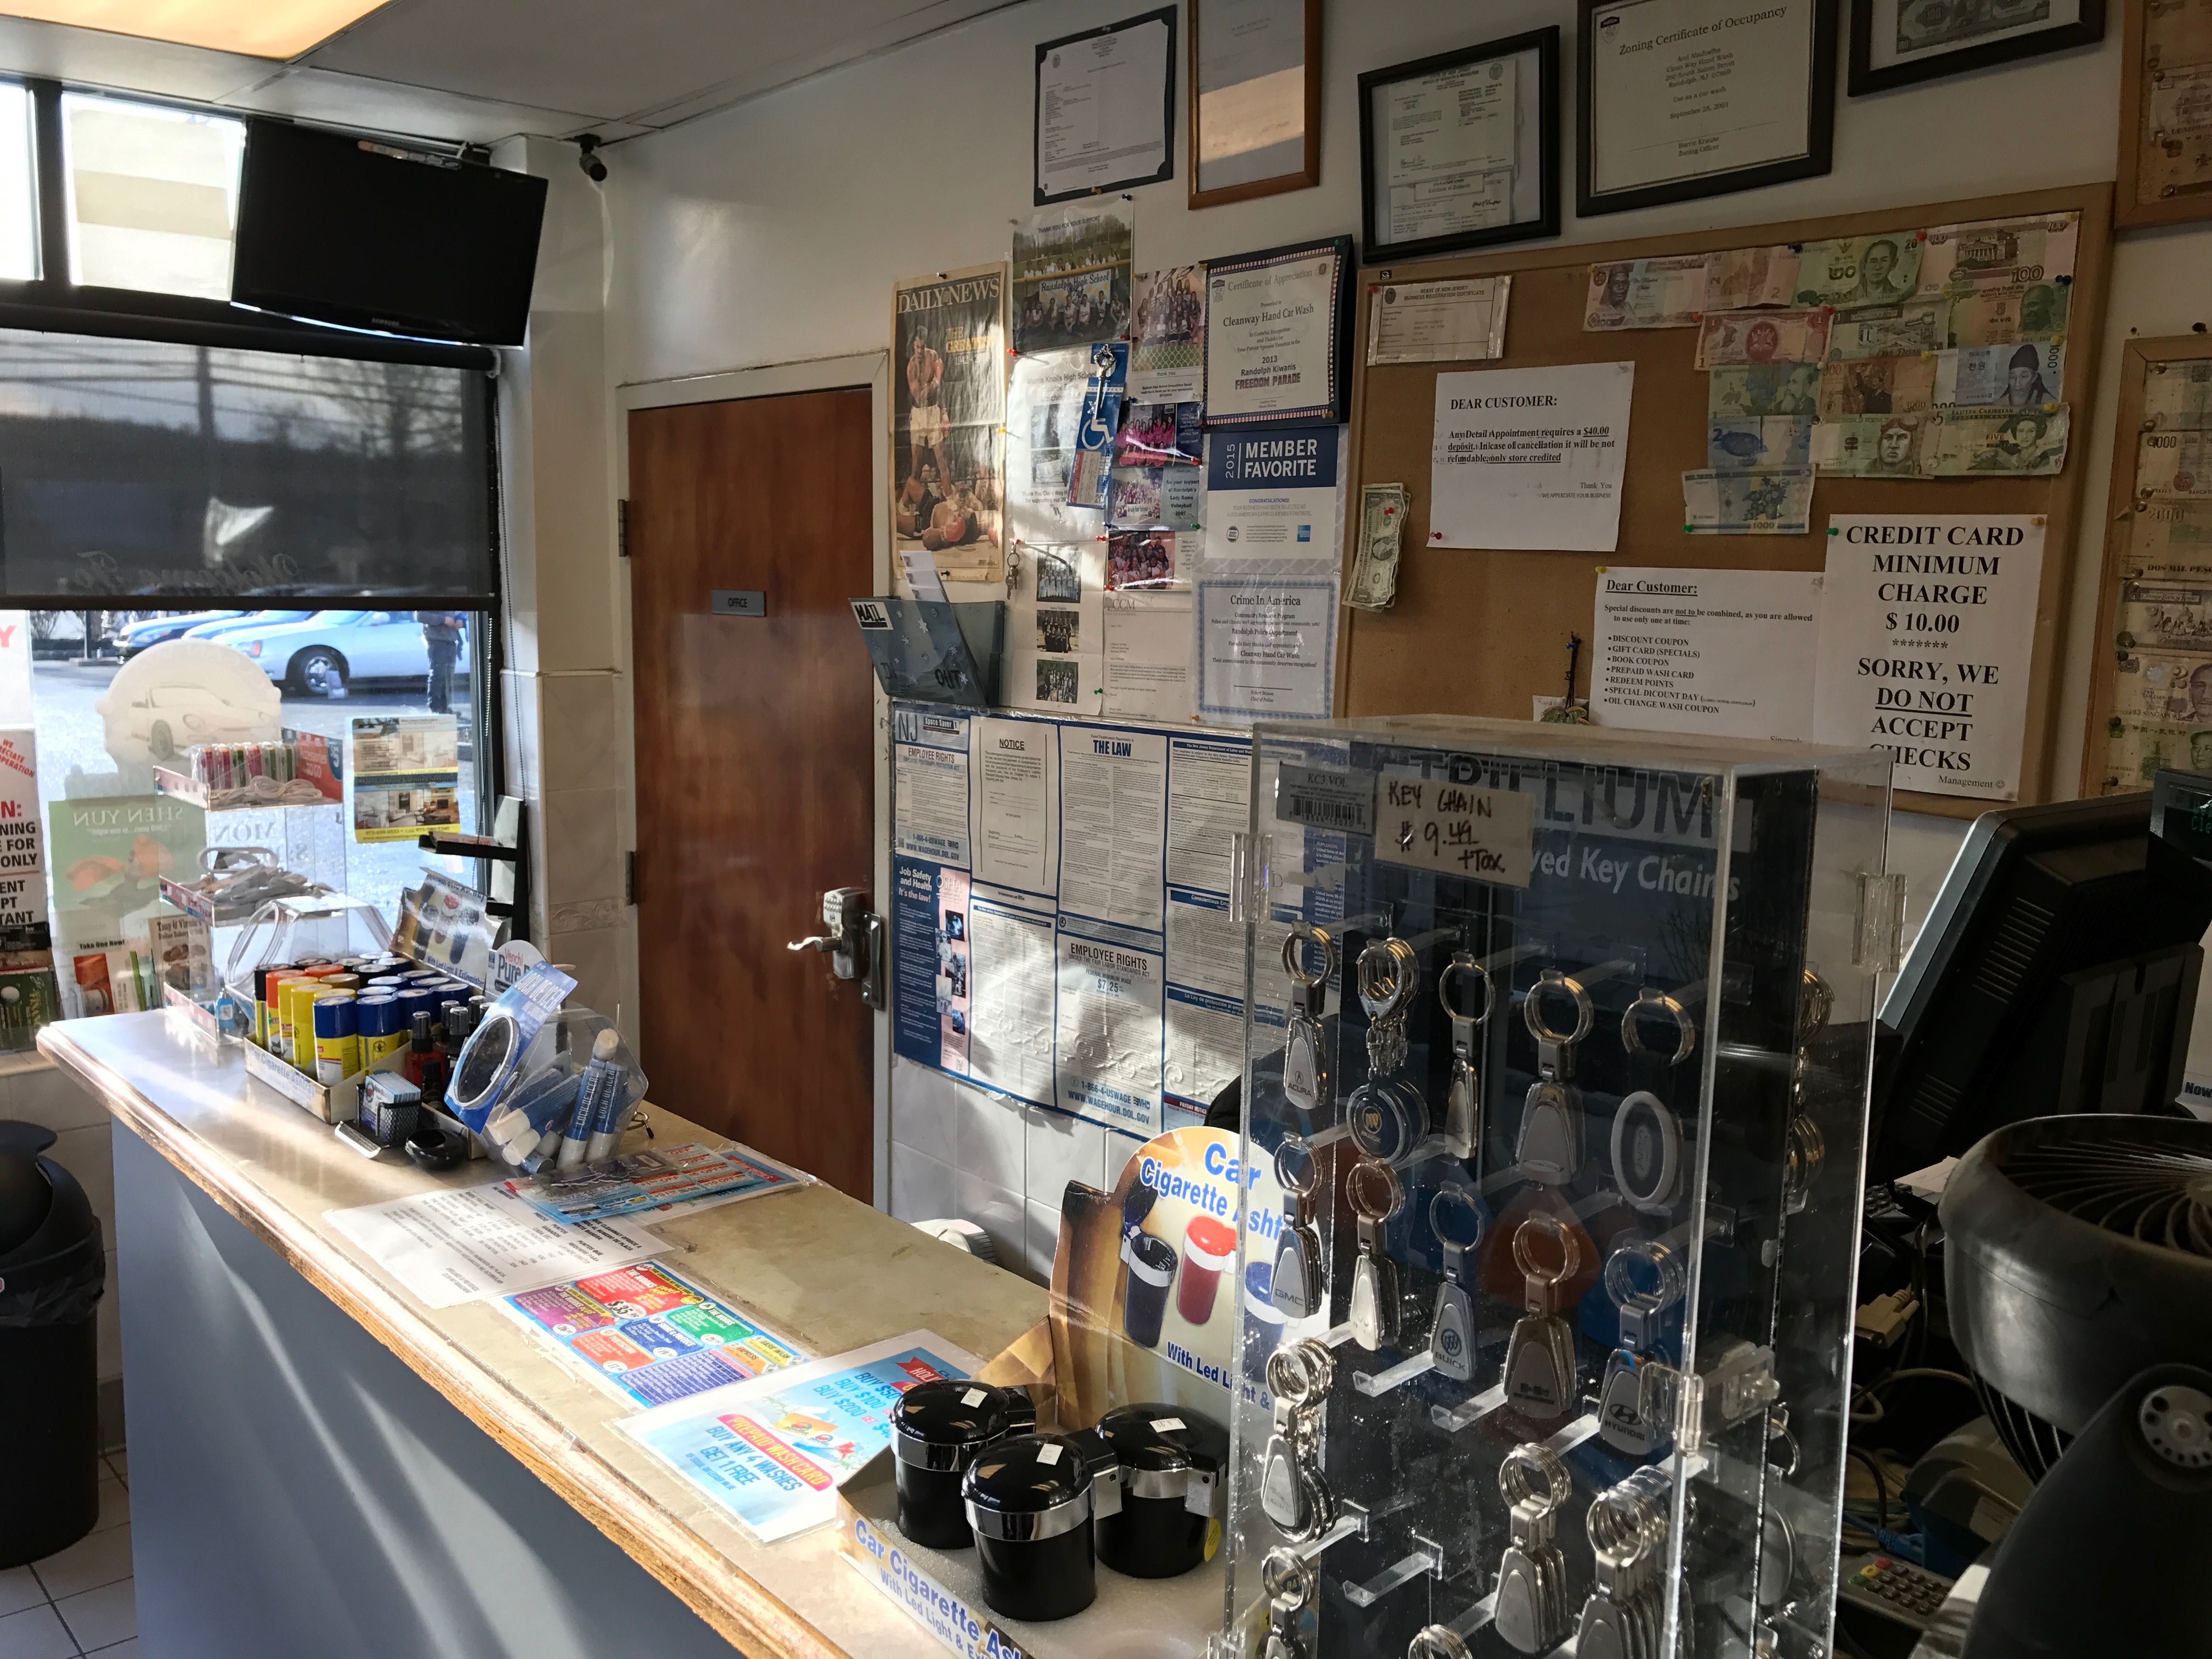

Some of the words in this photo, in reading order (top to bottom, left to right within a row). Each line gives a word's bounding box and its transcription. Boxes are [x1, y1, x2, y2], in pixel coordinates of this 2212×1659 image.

[1620, 39, 1653, 55] Zoning
[1656, 25, 1709, 45] Certificate
[1712, 20, 1723, 32] of
[1725, 7, 1787, 29] Occupancy
[2048, 221, 2066, 232] 100
[1905, 238, 1918, 250] 20
[2011, 264, 2044, 283] 100
[898, 288, 944, 314] DAILY
[947, 278, 999, 305] NEWS
[1771, 286, 1781, 299] 2
[1223, 314, 1260, 327] Cleanway
[1262, 309, 1281, 321] Hand
[1283, 308, 1294, 319] Car
[1295, 304, 1313, 316] Wash
[1241, 368, 1271, 376] Randolph
[1273, 364, 1296, 373] Kiwanis
[1235, 377, 1269, 390] FREEDOM
[1272, 373, 1301, 386] PARADE
[1451, 399, 1482, 410] DEAR
[1485, 396, 1558, 408] CUSTOMER:
[1246, 439, 1317, 458] MEMBER
[1226, 444, 1235, 478] 2015
[1245, 459, 1316, 478] FAVORITE
[1847, 526, 1940, 545] CREDIT
[1948, 527, 2024, 546] CARD
[1872, 555, 2000, 575] MINIMUM
[2147, 563, 2167, 572] DOS
[1606, 579, 1633, 592] Dear
[1637, 580, 1697, 594] Customer:
[1878, 584, 1987, 605] CHARGE
[728, 597, 747, 608] OFFICE
[1231, 595, 1254, 605] Crime
[1256, 596, 1264, 605] In
[1267, 596, 1301, 606] America
[854, 604, 885, 622] MAIL
[1630, 606, 1661, 614] discounts
[1707, 610, 1743, 618] combined,
[1784, 613, 1812, 622] allowed
[1634, 616, 1649, 625] only
[1886, 612, 1897, 631] $
[1905, 613, 1959, 633] 10.00
[1613, 635, 1653, 645] DISCOUNT
[1655, 637, 1689, 646] COUPON
[1612, 656, 1634, 664] BOOK
[1637, 657, 1669, 666] COUPON
[1657, 648, 1700, 659] (SPECIALS)
[934, 668, 965, 690] OUT
[1611, 666, 1644, 675] PREPAID
[1646, 669, 1670, 677] WASH
[1672, 670, 1694, 679] CARD
[1858, 658, 1948, 685] SORRY,
[1957, 664, 1999, 685] WE
[1611, 676, 1643, 685] REDEEM
[1645, 679, 1673, 688] POINTS
[1609, 687, 1641, 696] SPECIAL
[1644, 690, 1680, 699] DICOUNT
[1682, 692, 1698, 701] DAY
[1877, 687, 1911, 707] DO
[1918, 690, 1973, 712] NOT
[1624, 699, 1657, 708] CHANGE
[1660, 702, 1683, 710] WASH
[1685, 703, 1719, 713] COUPON
[898, 713, 918, 741] NJ
[1871, 716, 1973, 741] ACCEPT
[1000, 739, 1024, 749] NOTICE
[1093, 740, 1110, 754] THE
[1112, 742, 1131, 757] LAW
[909, 748, 934, 759] EMPLOYEE
[936, 752, 955, 763] RIGHTS
[1939, 775, 1993, 788] Management
[1389, 781, 1422, 809] KEY
[1437, 789, 1491, 818] CHAIN
[7, 839, 35, 850] FOR
[1395, 821, 1414, 853] $
[1458, 849, 1505, 873] +Tax
[900, 866, 912, 877] Job
[913, 869, 932, 882] Safety
[936, 874, 962, 893] OSHA
[1581, 847, 1629, 895] Key
[1637, 855, 1741, 902] Chains
[900, 877, 912, 887] and
[913, 879, 932, 891] Health
[899, 888, 908, 897] It's
[910, 890, 918, 900] the
[919, 891, 931, 903] law!
[505, 948, 523, 966] Venchi
[1070, 943, 1114, 962] EMPLOYEE
[1117, 953, 1147, 970] RIGHTS
[498, 953, 521, 984] Pure
[1097, 979, 1119, 993] $7.25
[1081, 1080, 1131, 1104] 1-866-4-USWAGE
[1287, 1082, 1312, 1098] ACURA
[1204, 1142, 1261, 1190] Car
[1141, 1158, 1228, 1217] Cigarette
[1275, 1289, 1305, 1307] GMC
[1435, 1351, 1466, 1373] BUICK
[1167, 1341, 1193, 1368] With
[1197, 1357, 1219, 1381] Led
[1222, 1373, 1256, 1403] Liht
[1260, 1391, 1270, 1410] &
[834, 1377, 862, 1393] BUY
[856, 1391, 887, 1409] $100
[1604, 1419, 1646, 1442] HYUNDAI
[706, 1425, 737, 1442] BUY
[726, 1438, 755, 1457] ANY
[754, 1459, 803, 1491] WASHES
[726, 1417, 769, 1447] PREPAID
[766, 1444, 797, 1467] WASH
[793, 1462, 830, 1486] CARD
[700, 1446, 729, 1463] GET
[721, 1460, 735, 1469] 1
[729, 1465, 760, 1486] FREE
[855, 1519, 884, 1560] Car
[890, 1550, 979, 1642] Cigarette
[880, 1567, 902, 1598] With
[905, 1589, 923, 1616] Led
[926, 1606, 952, 1642] Light
[956, 1633, 964, 1652] &
